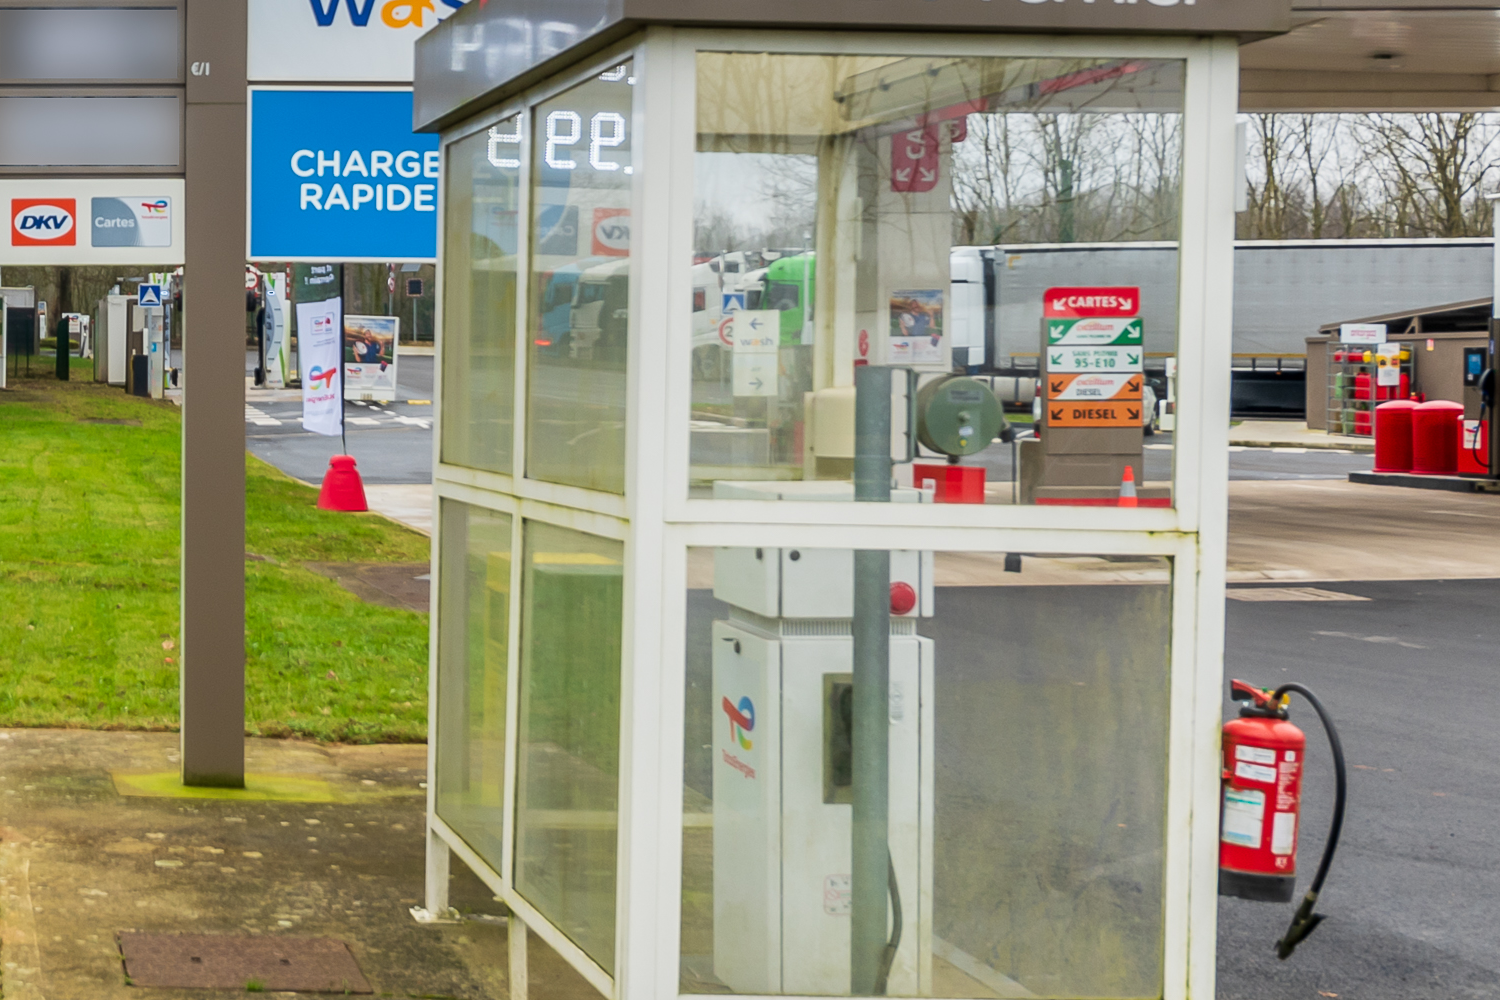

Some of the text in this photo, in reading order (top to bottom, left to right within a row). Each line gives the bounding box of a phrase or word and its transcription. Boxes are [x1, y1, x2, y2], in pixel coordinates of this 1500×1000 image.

[290, 150, 439, 178] CHARGE
[299, 183, 436, 211] RAPIDE
[20, 215, 68, 231] DKV
[94, 216, 135, 229] Cartes
[1067, 296, 1117, 308] CARTES
[1073, 409, 1117, 419] DIESEL
